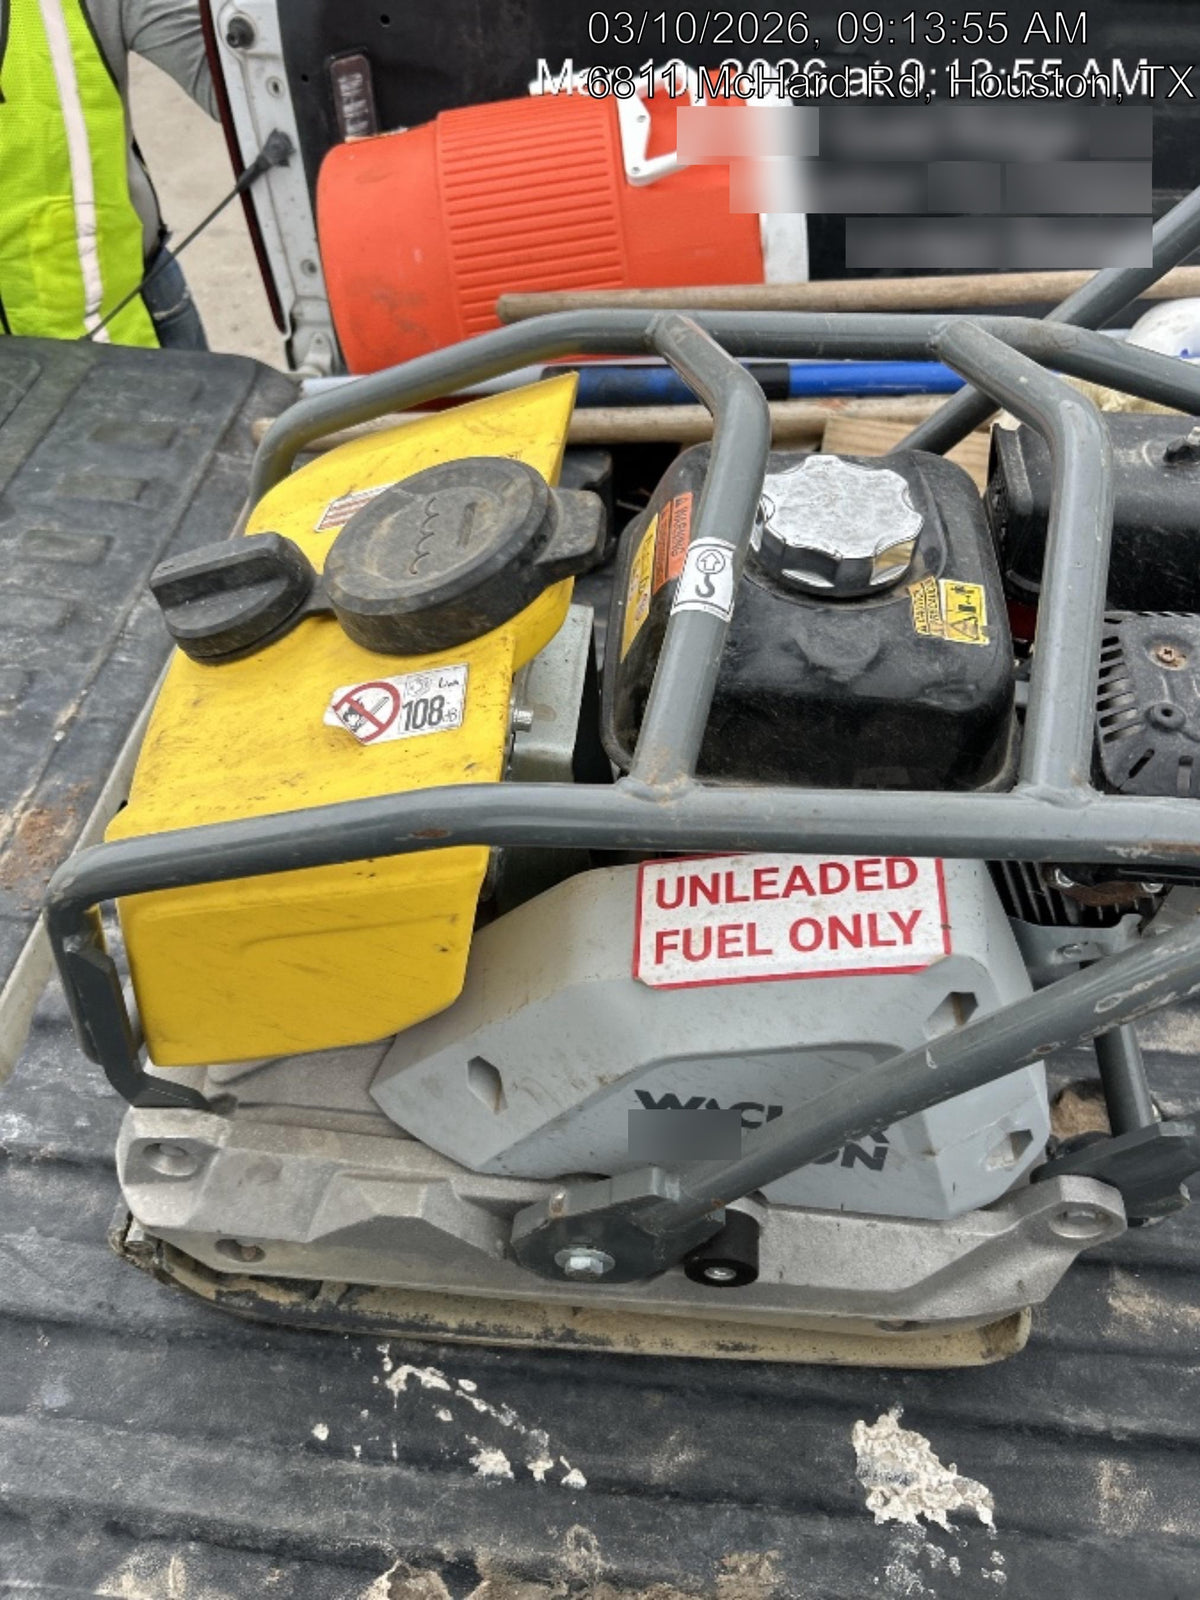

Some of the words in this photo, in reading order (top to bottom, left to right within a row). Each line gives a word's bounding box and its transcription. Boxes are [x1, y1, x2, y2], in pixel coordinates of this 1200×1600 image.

[402, 695, 445, 731] 108
[655, 857, 919, 910] UNLEADED
[654, 922, 773, 965] FUEL
[788, 909, 923, 952] ONLY
